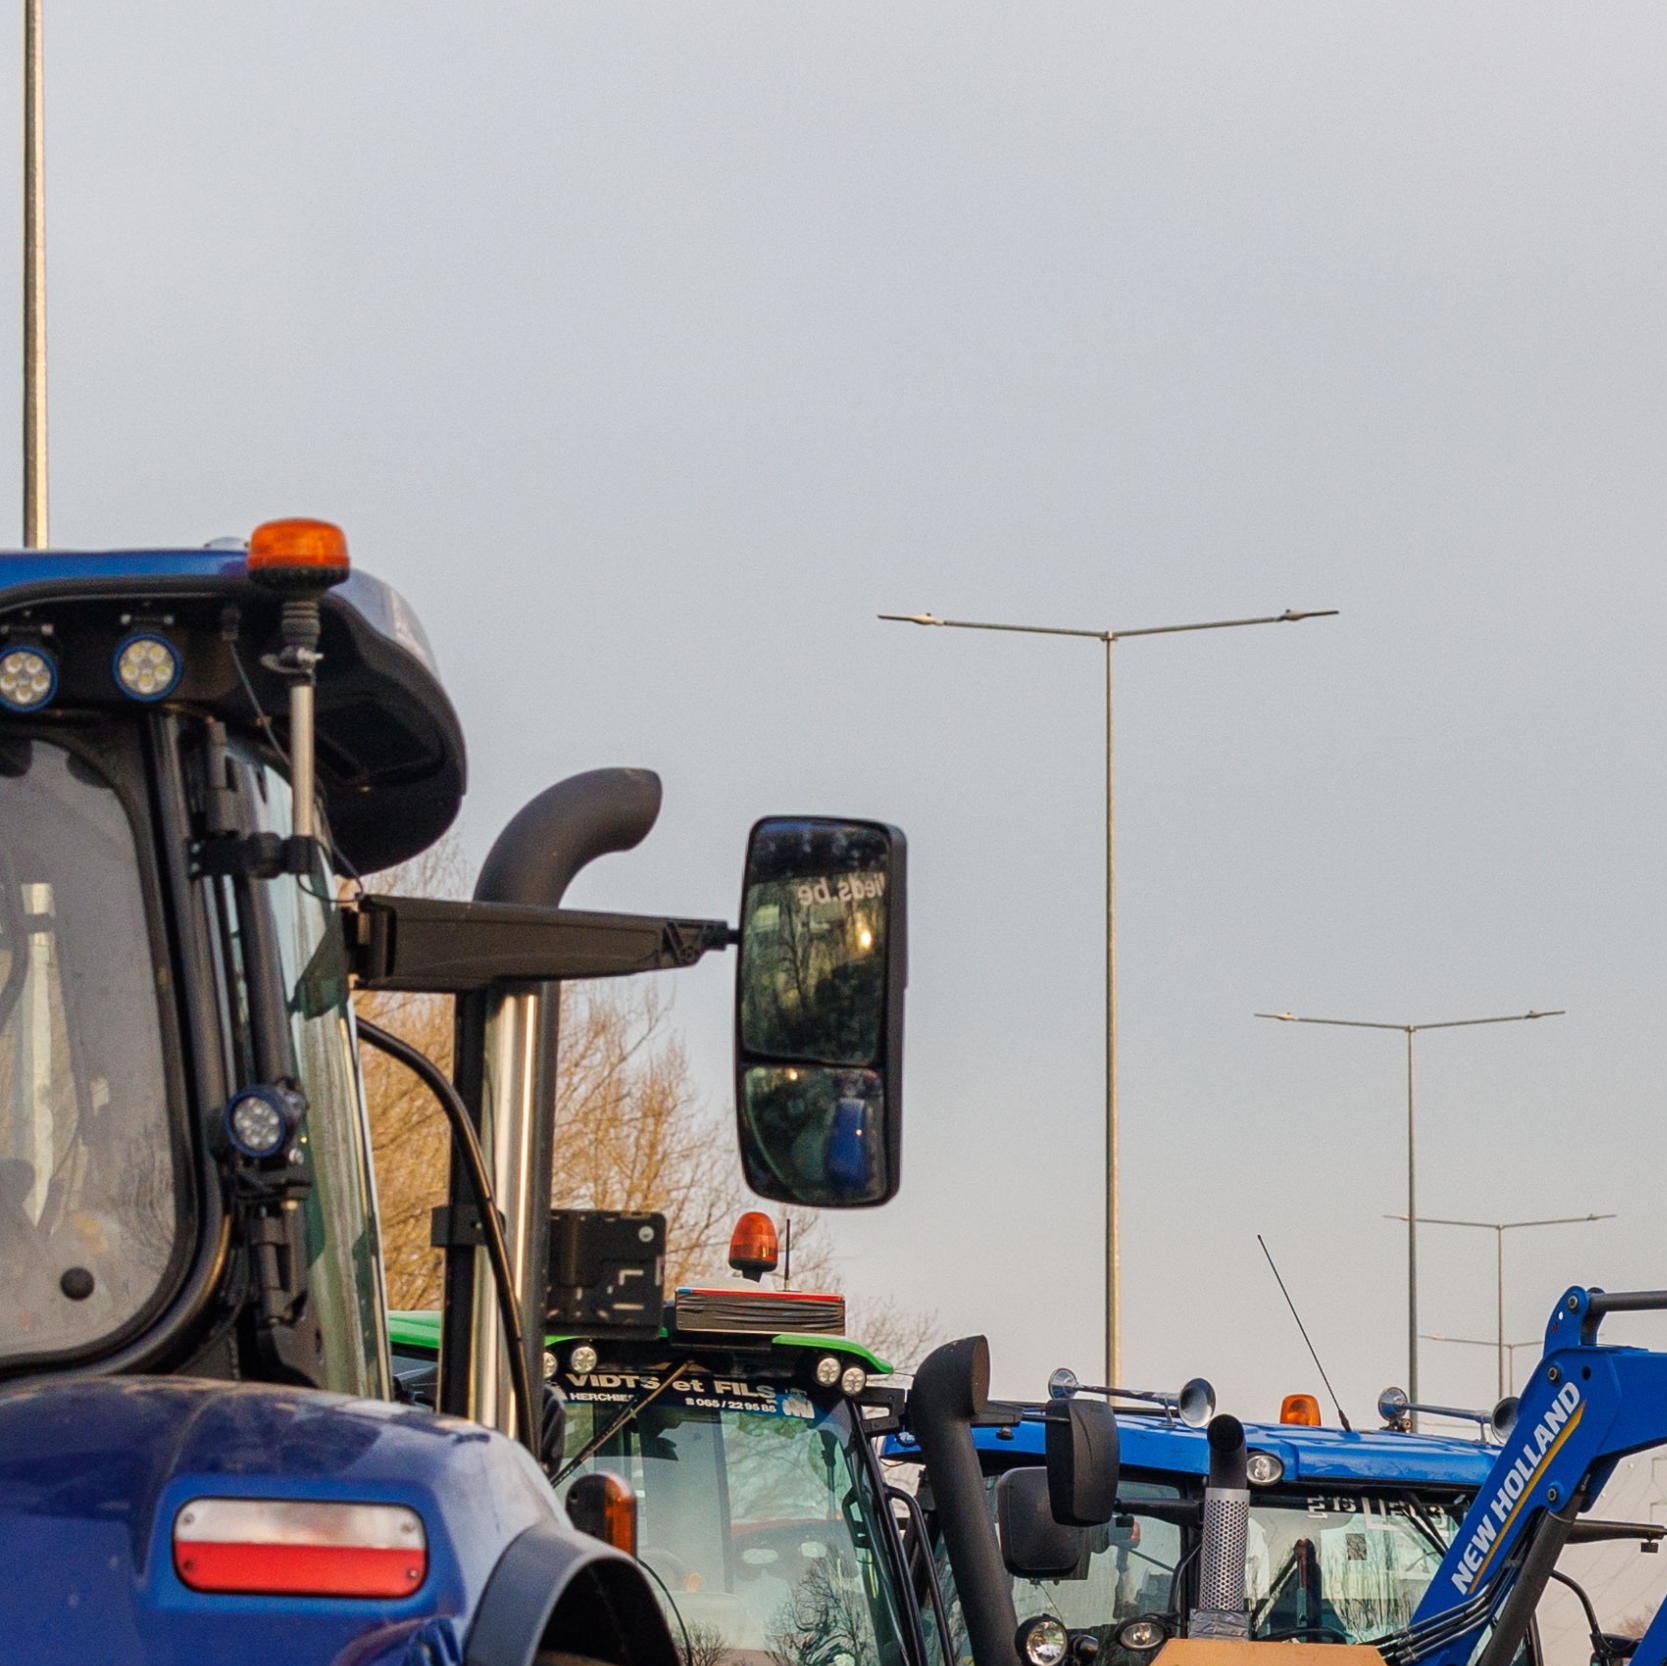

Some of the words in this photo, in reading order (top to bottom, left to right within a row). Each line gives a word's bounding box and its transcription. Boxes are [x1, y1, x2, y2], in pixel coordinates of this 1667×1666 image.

[565, 1372, 661, 1389] VIDTS
[672, 1380, 704, 1393] et
[713, 1380, 776, 1399] FILS
[1451, 1515, 1497, 1595] NEW
[1490, 1382, 1581, 1523] HOLLAND
